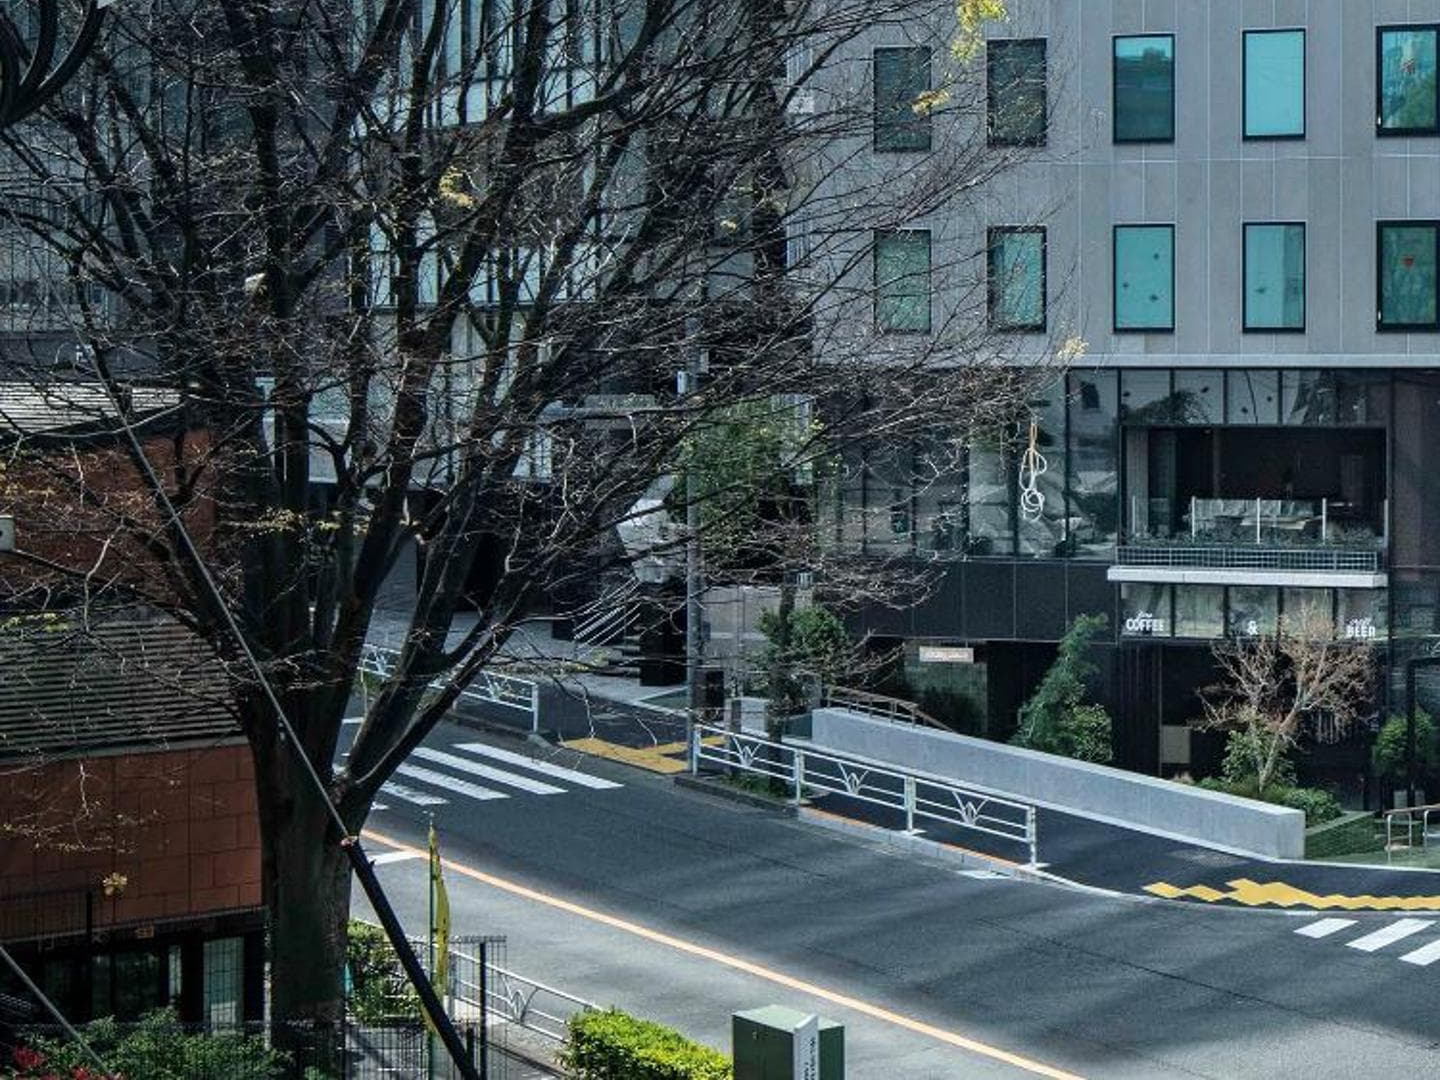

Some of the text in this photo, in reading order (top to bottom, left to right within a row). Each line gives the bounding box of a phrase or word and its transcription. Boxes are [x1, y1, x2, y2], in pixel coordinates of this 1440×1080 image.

[1126, 619, 1164, 632] COFFEE
[1249, 621, 1258, 635] &
[1346, 625, 1376, 638] BEER
